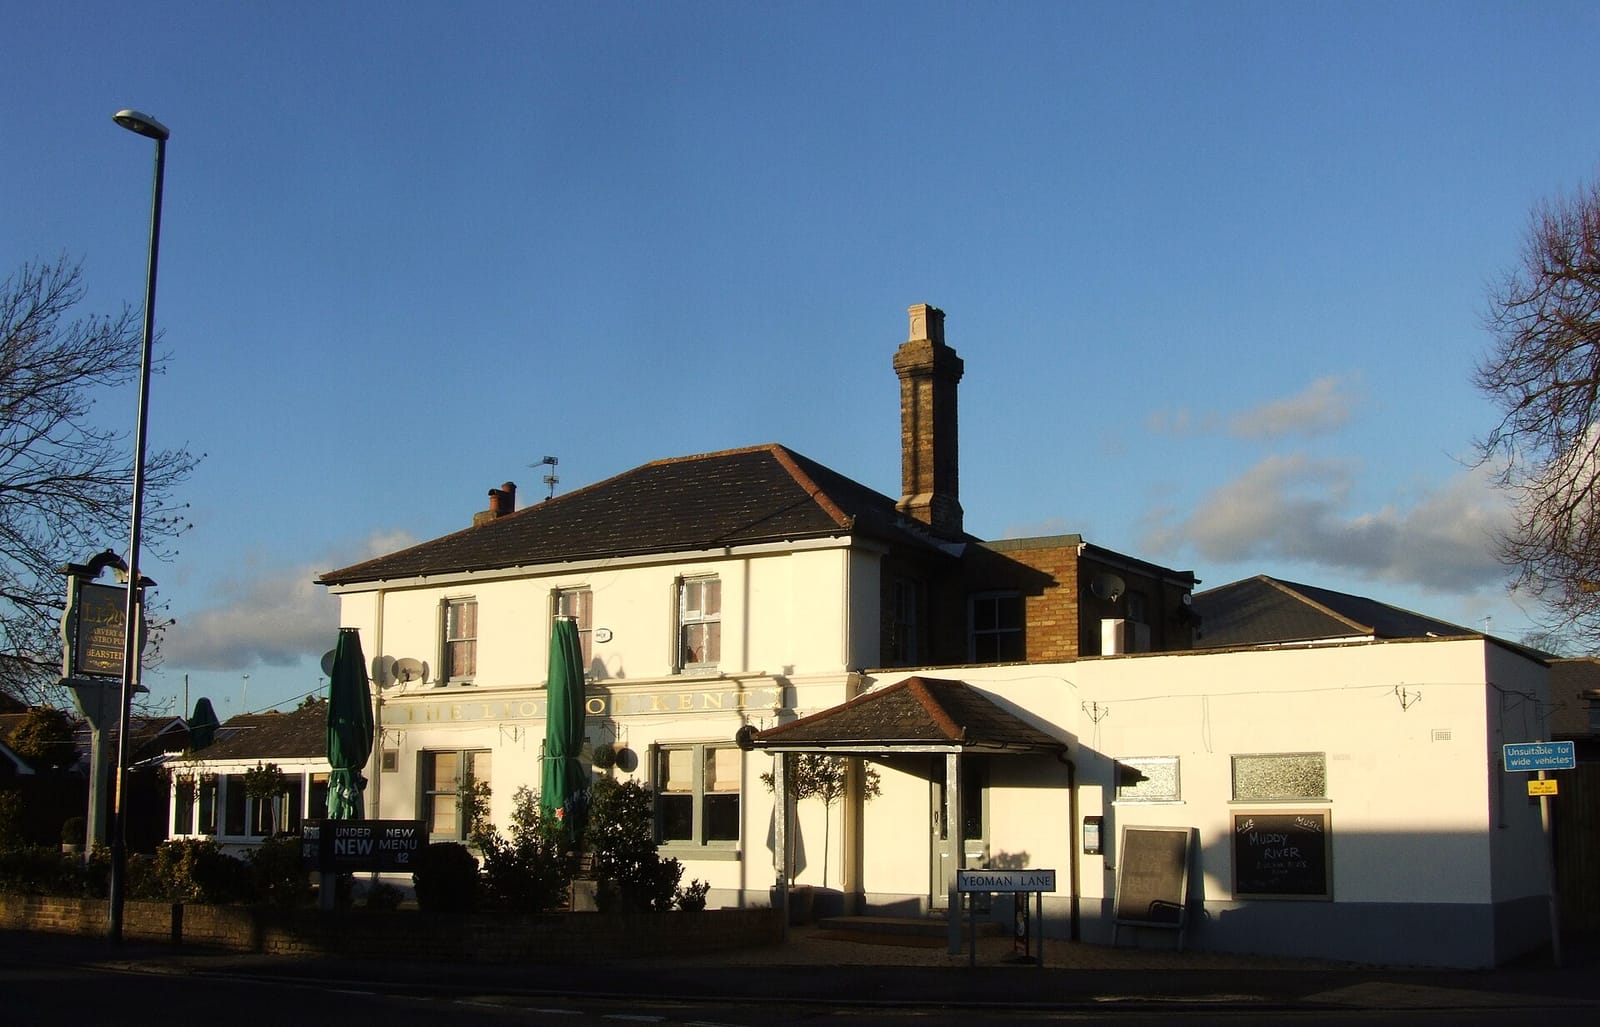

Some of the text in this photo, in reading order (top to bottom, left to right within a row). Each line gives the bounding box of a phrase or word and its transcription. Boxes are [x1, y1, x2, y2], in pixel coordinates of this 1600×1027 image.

[406, 691, 753, 721] THE LIO OF KENT
[1507, 746, 1569, 756] Unsuitable for
[1511, 756, 1570, 766] wide vehicles
[1236, 815, 1322, 833] LIVE MUSIC
[335, 827, 372, 838] UNDER
[386, 828, 415, 838] NEW
[1249, 831, 1288, 846] MUDDY
[334, 839, 375, 856] NEW
[379, 839, 418, 850] MENU
[1264, 847, 1301, 859] RIVER
[962, 876, 1051, 886] YEOMAN LANE
